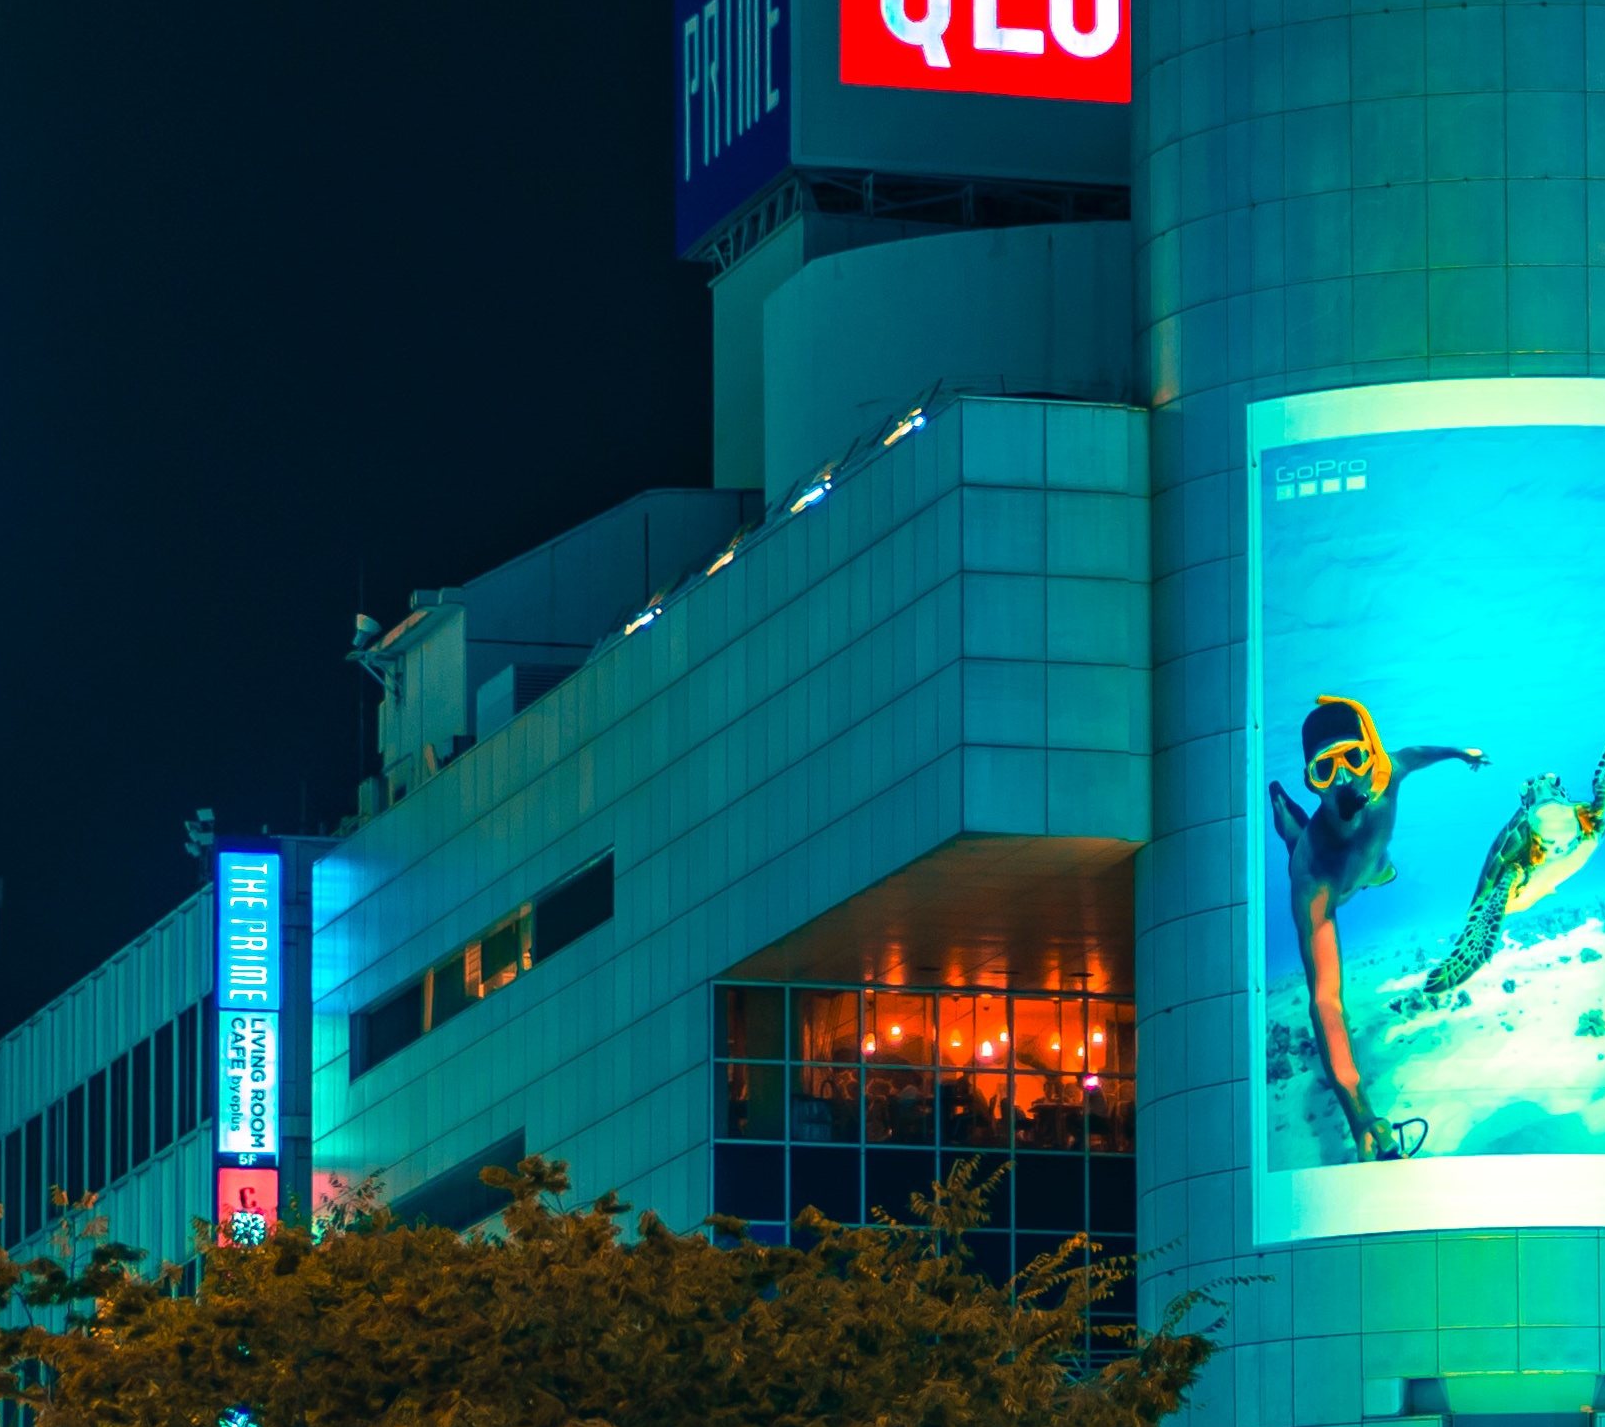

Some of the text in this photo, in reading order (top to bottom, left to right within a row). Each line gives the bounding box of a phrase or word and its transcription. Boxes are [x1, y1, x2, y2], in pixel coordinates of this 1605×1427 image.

[1273, 457, 1369, 483] GoPro
[229, 862, 268, 1002] THE PRIME
[230, 1017, 247, 1071] CAFE
[249, 1017, 268, 1150] LIVING ROOM
